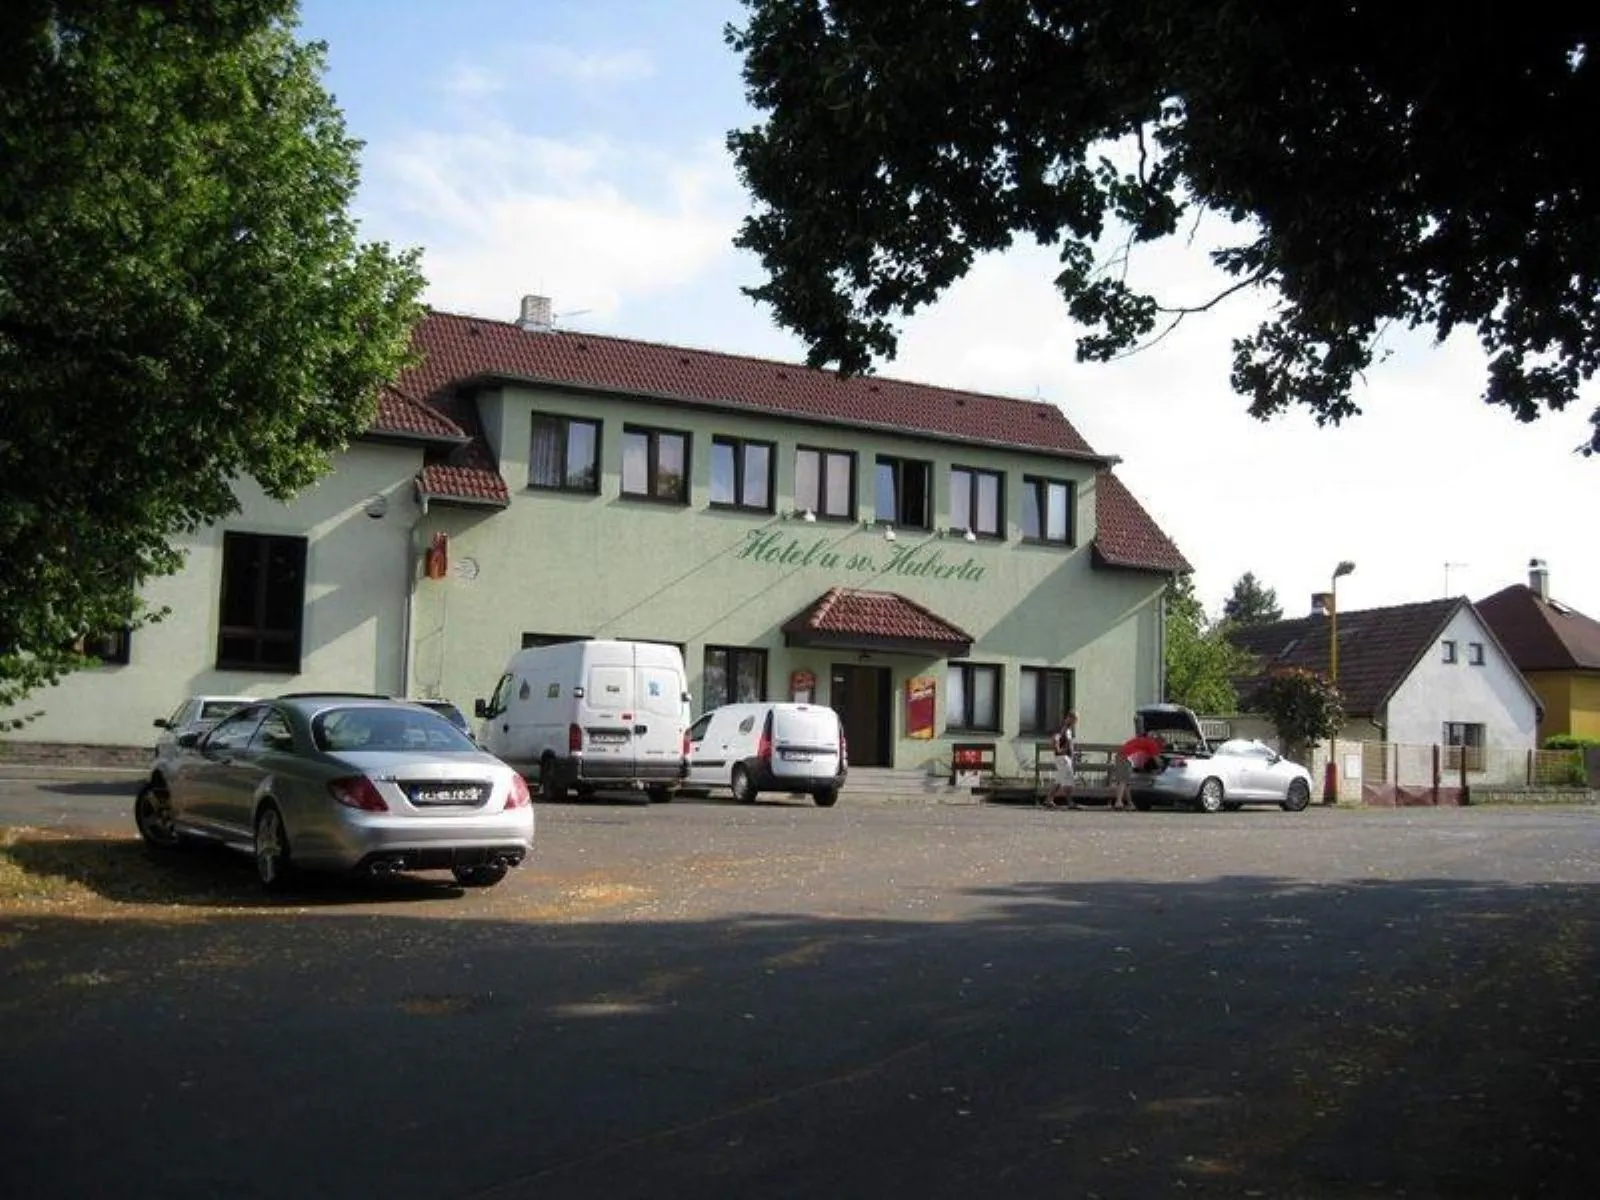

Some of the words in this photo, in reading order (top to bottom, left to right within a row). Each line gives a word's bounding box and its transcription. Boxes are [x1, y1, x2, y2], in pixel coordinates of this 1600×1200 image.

[736, 529, 827, 567] Hotel
[819, 552, 840, 568] u
[845, 553, 877, 572] sv.
[881, 543, 986, 581] Huberta
